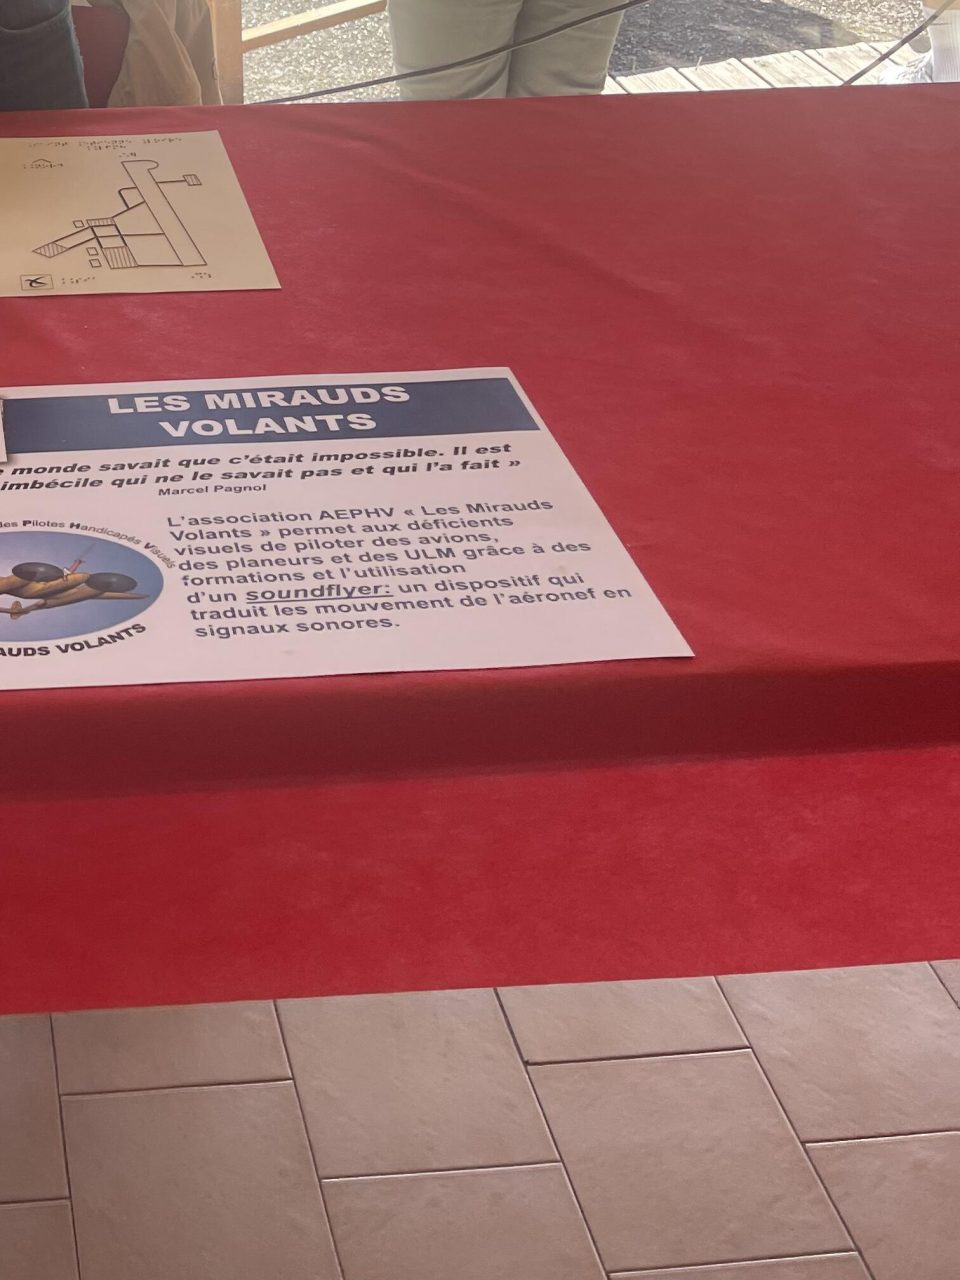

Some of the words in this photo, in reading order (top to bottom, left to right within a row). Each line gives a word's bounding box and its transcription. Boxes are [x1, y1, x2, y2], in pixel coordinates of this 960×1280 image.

[107, 393, 190, 414] LES
[205, 385, 410, 409] MIRAUDS
[159, 413, 376, 437] VOLANTS
[11, 463, 91, 475] monde
[99, 458, 171, 471] savait
[178, 458, 220, 468] que
[312, 448, 444, 464] impossible.
[453, 446, 467, 455] Il
[475, 444, 511, 454] est
[0, 478, 103, 491] imbécile
[111, 475, 148, 488] qui
[155, 475, 184, 483] ne
[192, 471, 213, 481] le
[221, 469, 293, 480] savait
[300, 469, 342, 480] pas
[351, 465, 374, 475] et
[382, 463, 417, 475] qui
[461, 459, 500, 470] fait
[158, 486, 208, 496] Marcel
[214, 484, 266, 494] Pagnol
[319, 507, 394, 520] AEPHV
[421, 506, 460, 515] Les
[466, 500, 553, 513] Mirauds
[169, 525, 252, 541] Volants
[277, 520, 356, 539] permet
[362, 523, 401, 533] aux
[407, 514, 514, 531] déficients
[69, 522, 142, 546] Handicapés
[143, 542, 177, 570] Visuels
[174, 542, 253, 556] visuels
[260, 541, 286, 552] de
[294, 539, 364, 553] piloter
[372, 536, 411, 547] des
[418, 533, 498, 547] avions,
[178, 560, 218, 571] des
[225, 550, 324, 571] planeurs
[331, 553, 352, 564] et
[358, 551, 398, 562] des
[404, 547, 456, 560] ULM
[462, 541, 525, 560] grâce
[532, 543, 545, 554] à
[551, 542, 591, 552] des
[181, 569, 305, 586] formations
[313, 569, 335, 580] et
[245, 581, 394, 604] soundflyer:
[398, 584, 427, 593] un
[434, 572, 540, 594] dispositif
[548, 573, 584, 587] qui
[190, 602, 268, 620] traduit
[273, 601, 308, 616] les
[314, 596, 454, 614] mouvement
[460, 595, 487, 607] de
[603, 589, 632, 598] en
[55, 622, 146, 654] VOLANTS
[195, 624, 290, 639] signaux
[296, 618, 400, 632] sonores.
